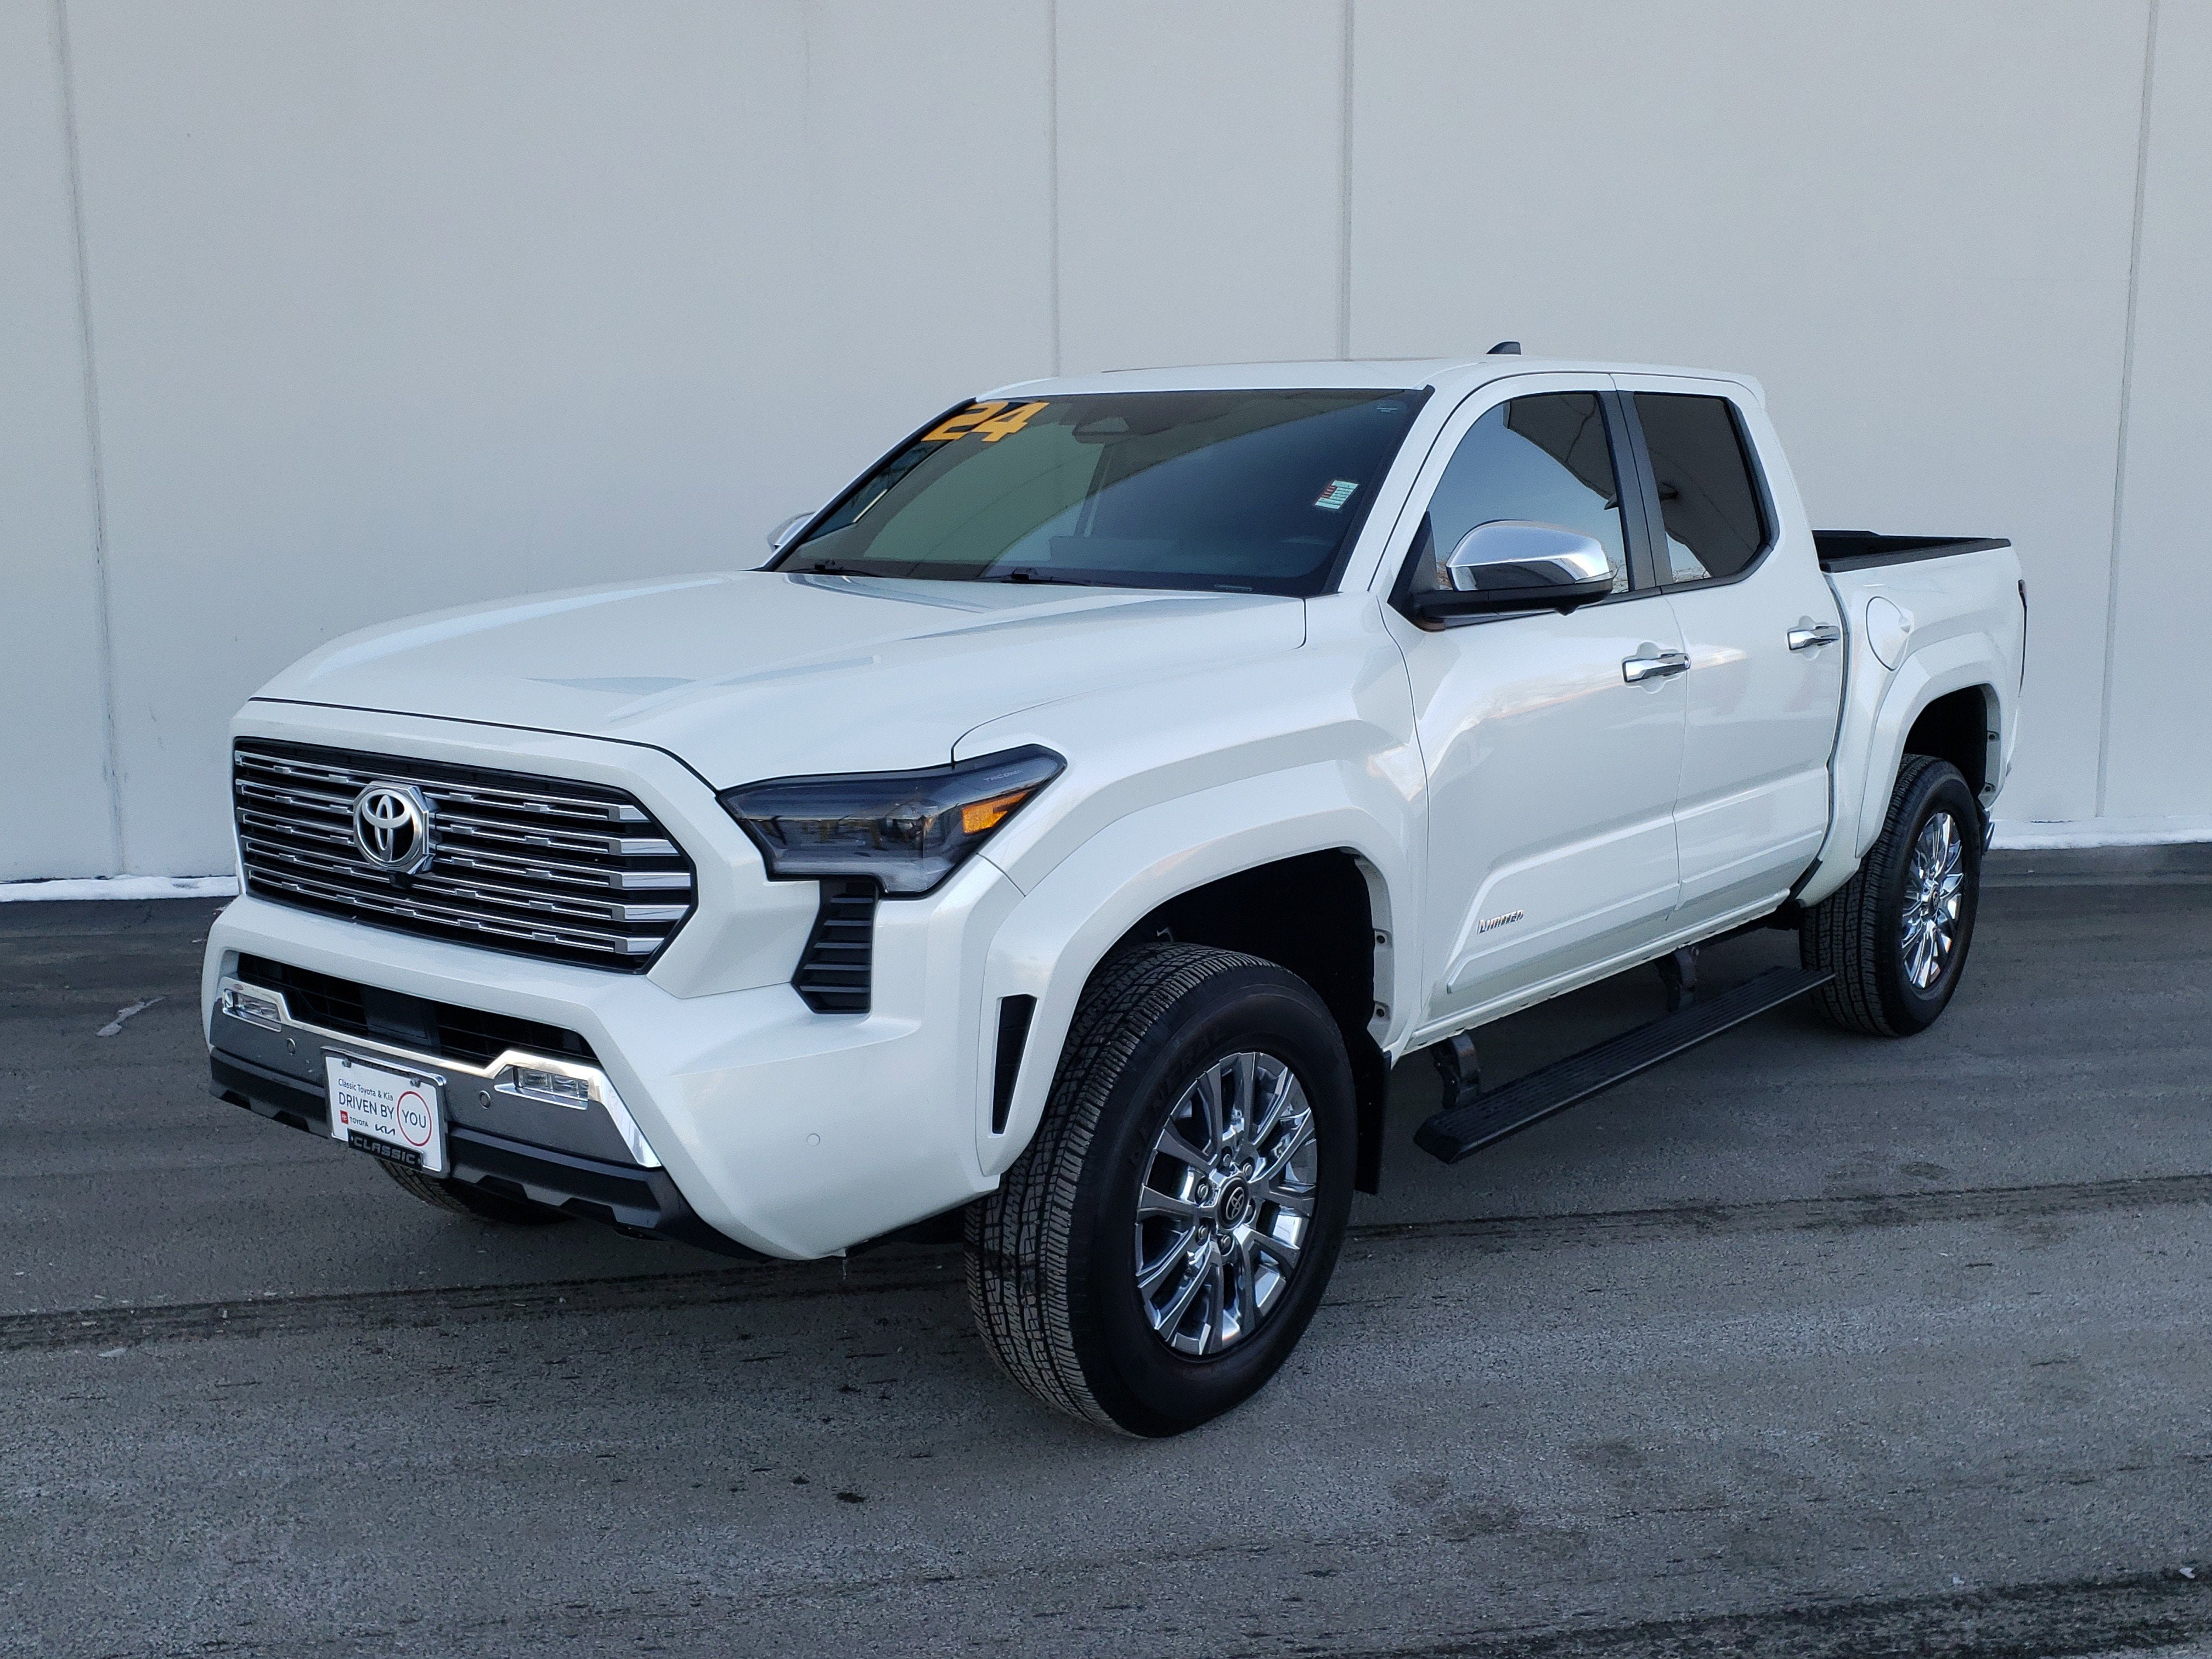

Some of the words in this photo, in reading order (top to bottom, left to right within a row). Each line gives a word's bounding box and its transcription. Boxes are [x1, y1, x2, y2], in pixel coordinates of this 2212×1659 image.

[921, 401, 1050, 442] 24
[338, 1078, 357, 1091] Classic
[357, 1084, 376, 1098] Toyota
[383, 1092, 393, 1101] Kia
[338, 1092, 377, 1115] DRIVEN
[381, 1104, 394, 1120] BY
[402, 1109, 426, 1128] YOU
[349, 1116, 369, 1127] TOYOTA
[352, 1136, 415, 1165] CLASSIC
